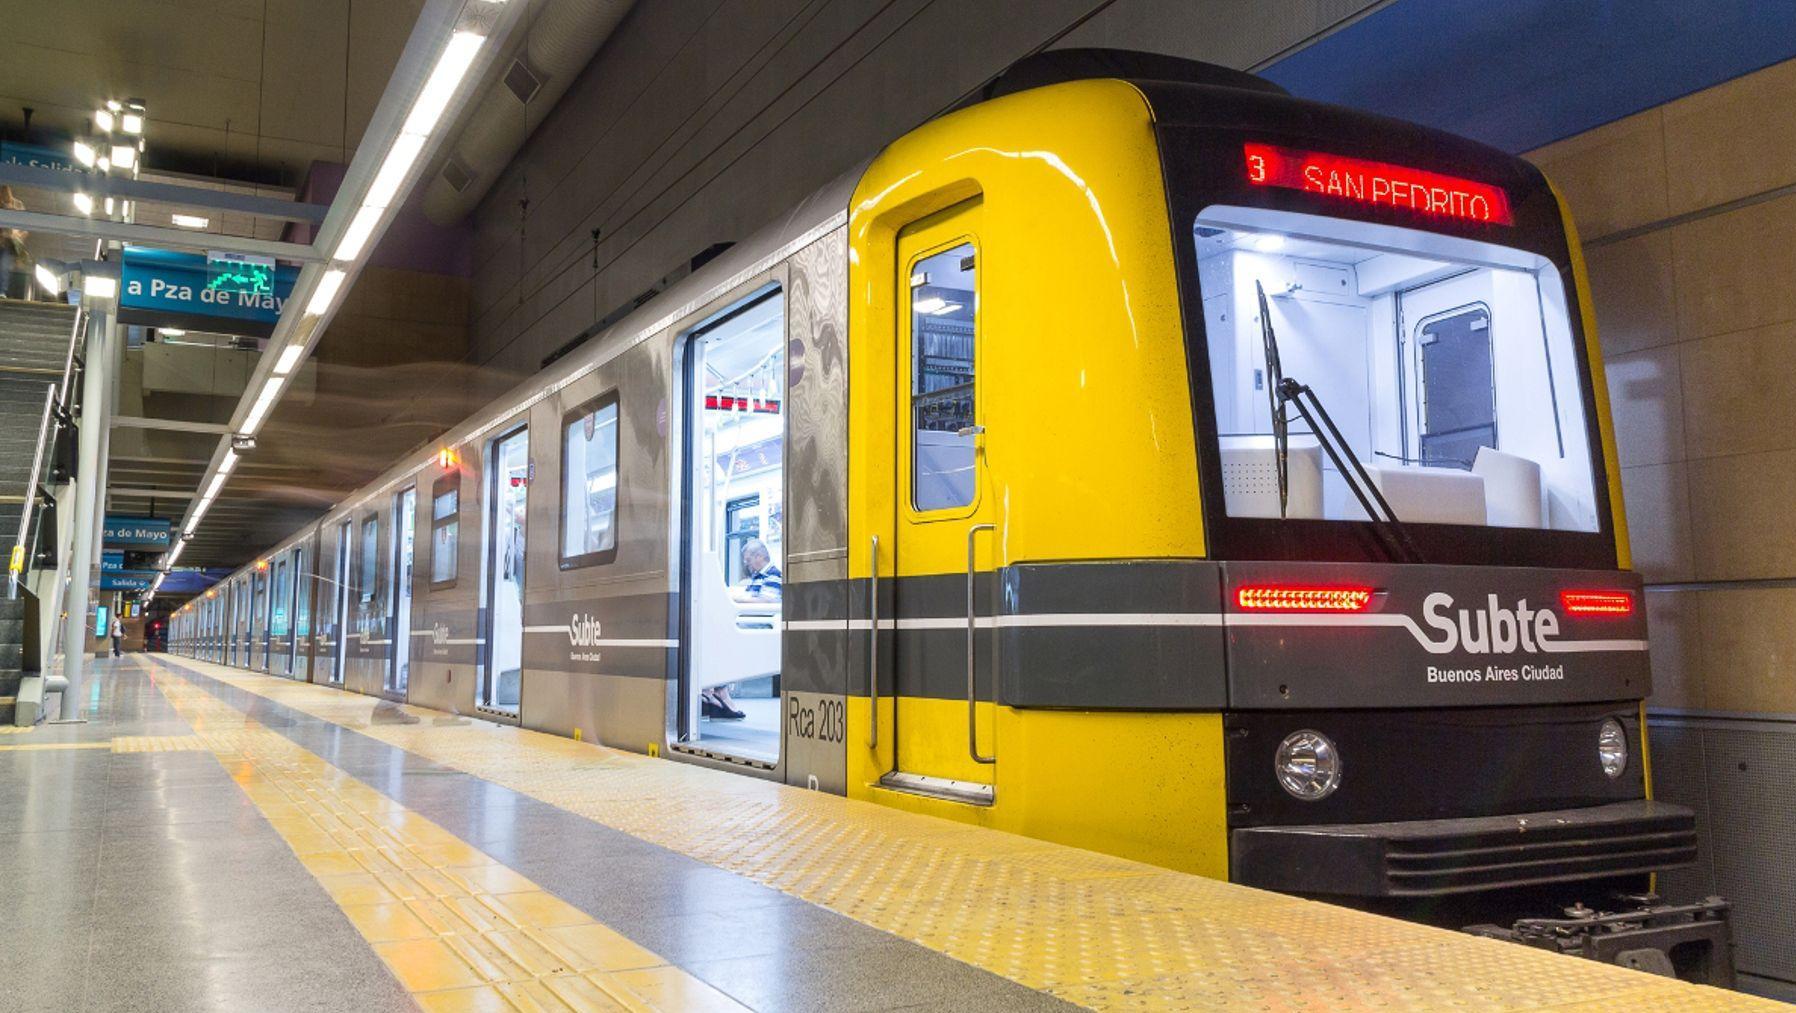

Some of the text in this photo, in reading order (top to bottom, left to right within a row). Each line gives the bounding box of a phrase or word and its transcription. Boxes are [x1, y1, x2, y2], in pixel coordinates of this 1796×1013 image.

[1249, 155, 1265, 181] 3
[1304, 165, 1364, 199] SAN
[127, 278, 284, 315] a Pza de May
[117, 528, 132, 537] de
[135, 529, 167, 540] Mayo
[570, 613, 601, 646] Subte
[1423, 592, 1560, 654] Subte
[1427, 664, 1564, 683] Buenos Aires Ciudad
[789, 696, 844, 743] Rca 203
